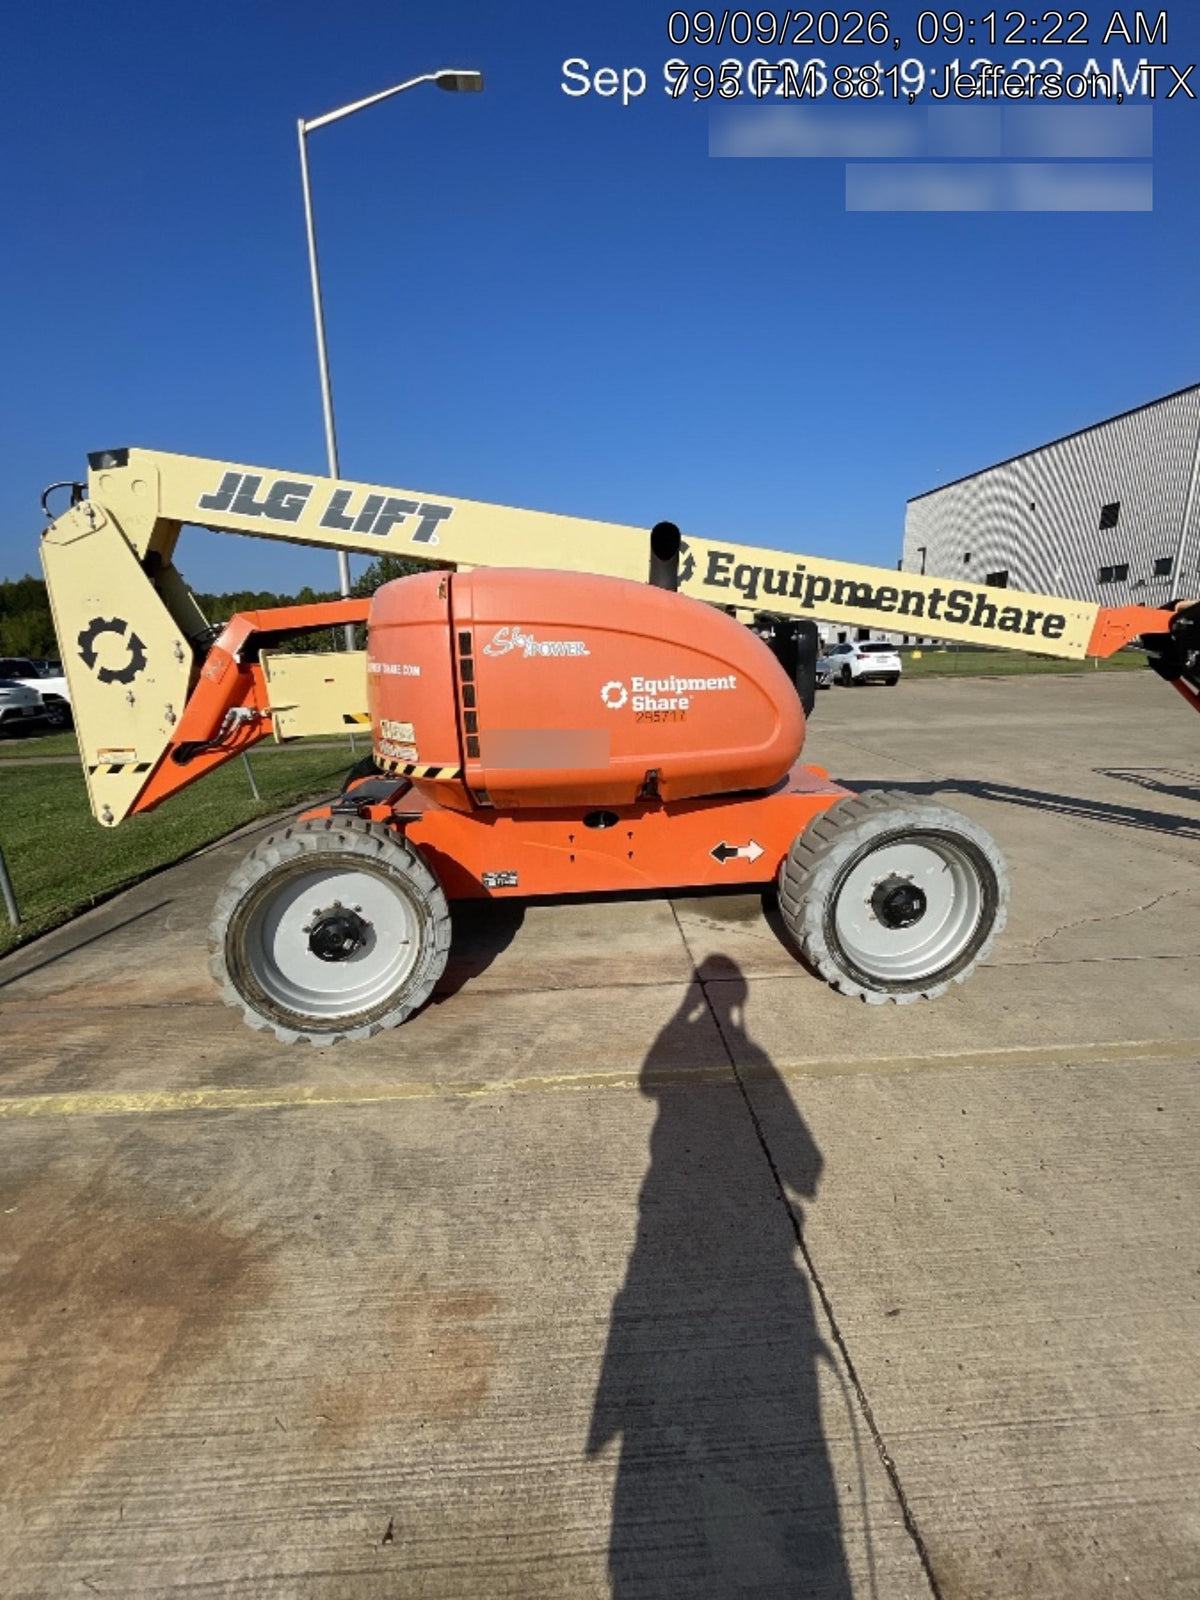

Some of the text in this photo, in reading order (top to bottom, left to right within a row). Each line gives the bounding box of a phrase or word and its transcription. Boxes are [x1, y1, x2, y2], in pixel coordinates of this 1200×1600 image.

[198, 470, 455, 543] JLG LIFT
[703, 550, 1066, 640] EquipmentShare
[631, 675, 737, 695] Equipment
[632, 696, 690, 712] Share
